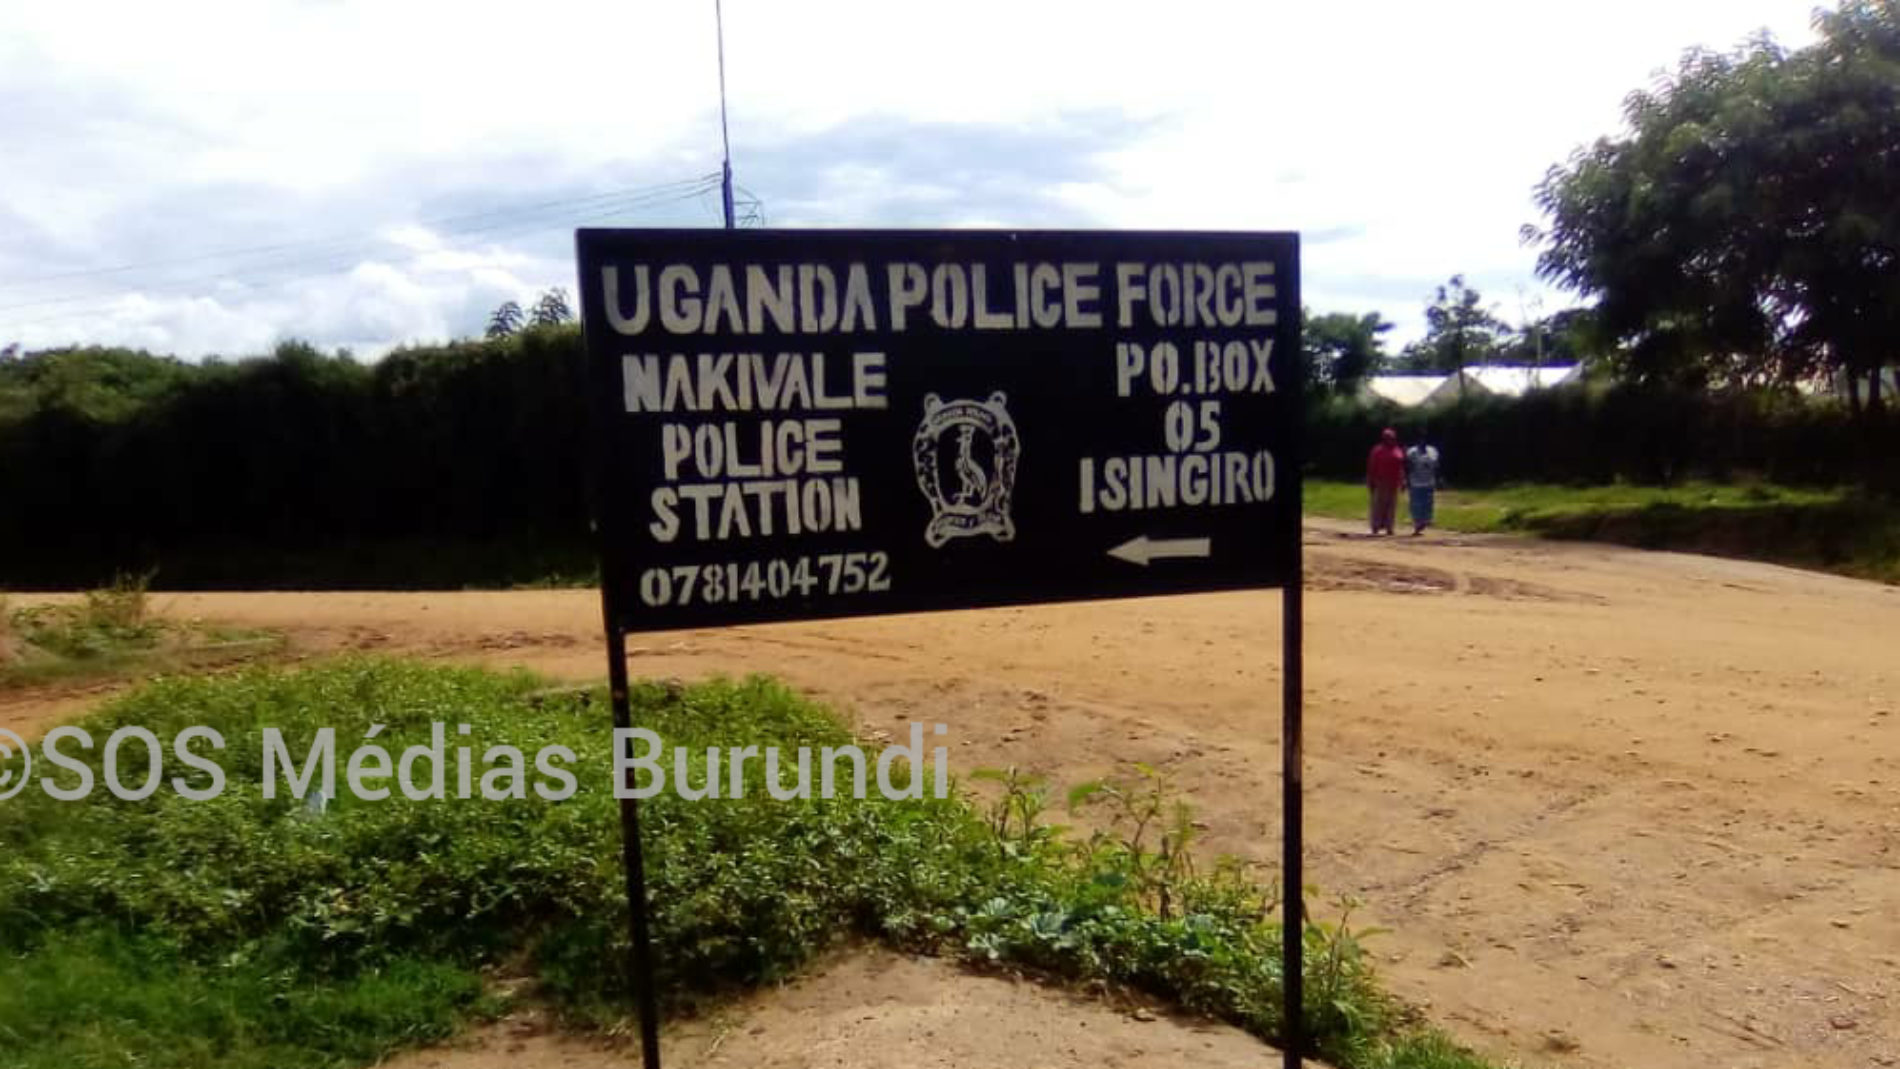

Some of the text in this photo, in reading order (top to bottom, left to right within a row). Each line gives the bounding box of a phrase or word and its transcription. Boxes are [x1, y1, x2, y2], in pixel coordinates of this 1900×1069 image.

[602, 262, 1277, 335] UGANDA POLICE FORCE
[622, 352, 887, 412] NAKIVALE
[662, 418, 843, 480] POLICE
[1164, 400, 1221, 453] 05
[649, 478, 862, 542] STATION
[1079, 450, 1275, 513] ISINGIRO
[639, 551, 891, 606] 0781404752
